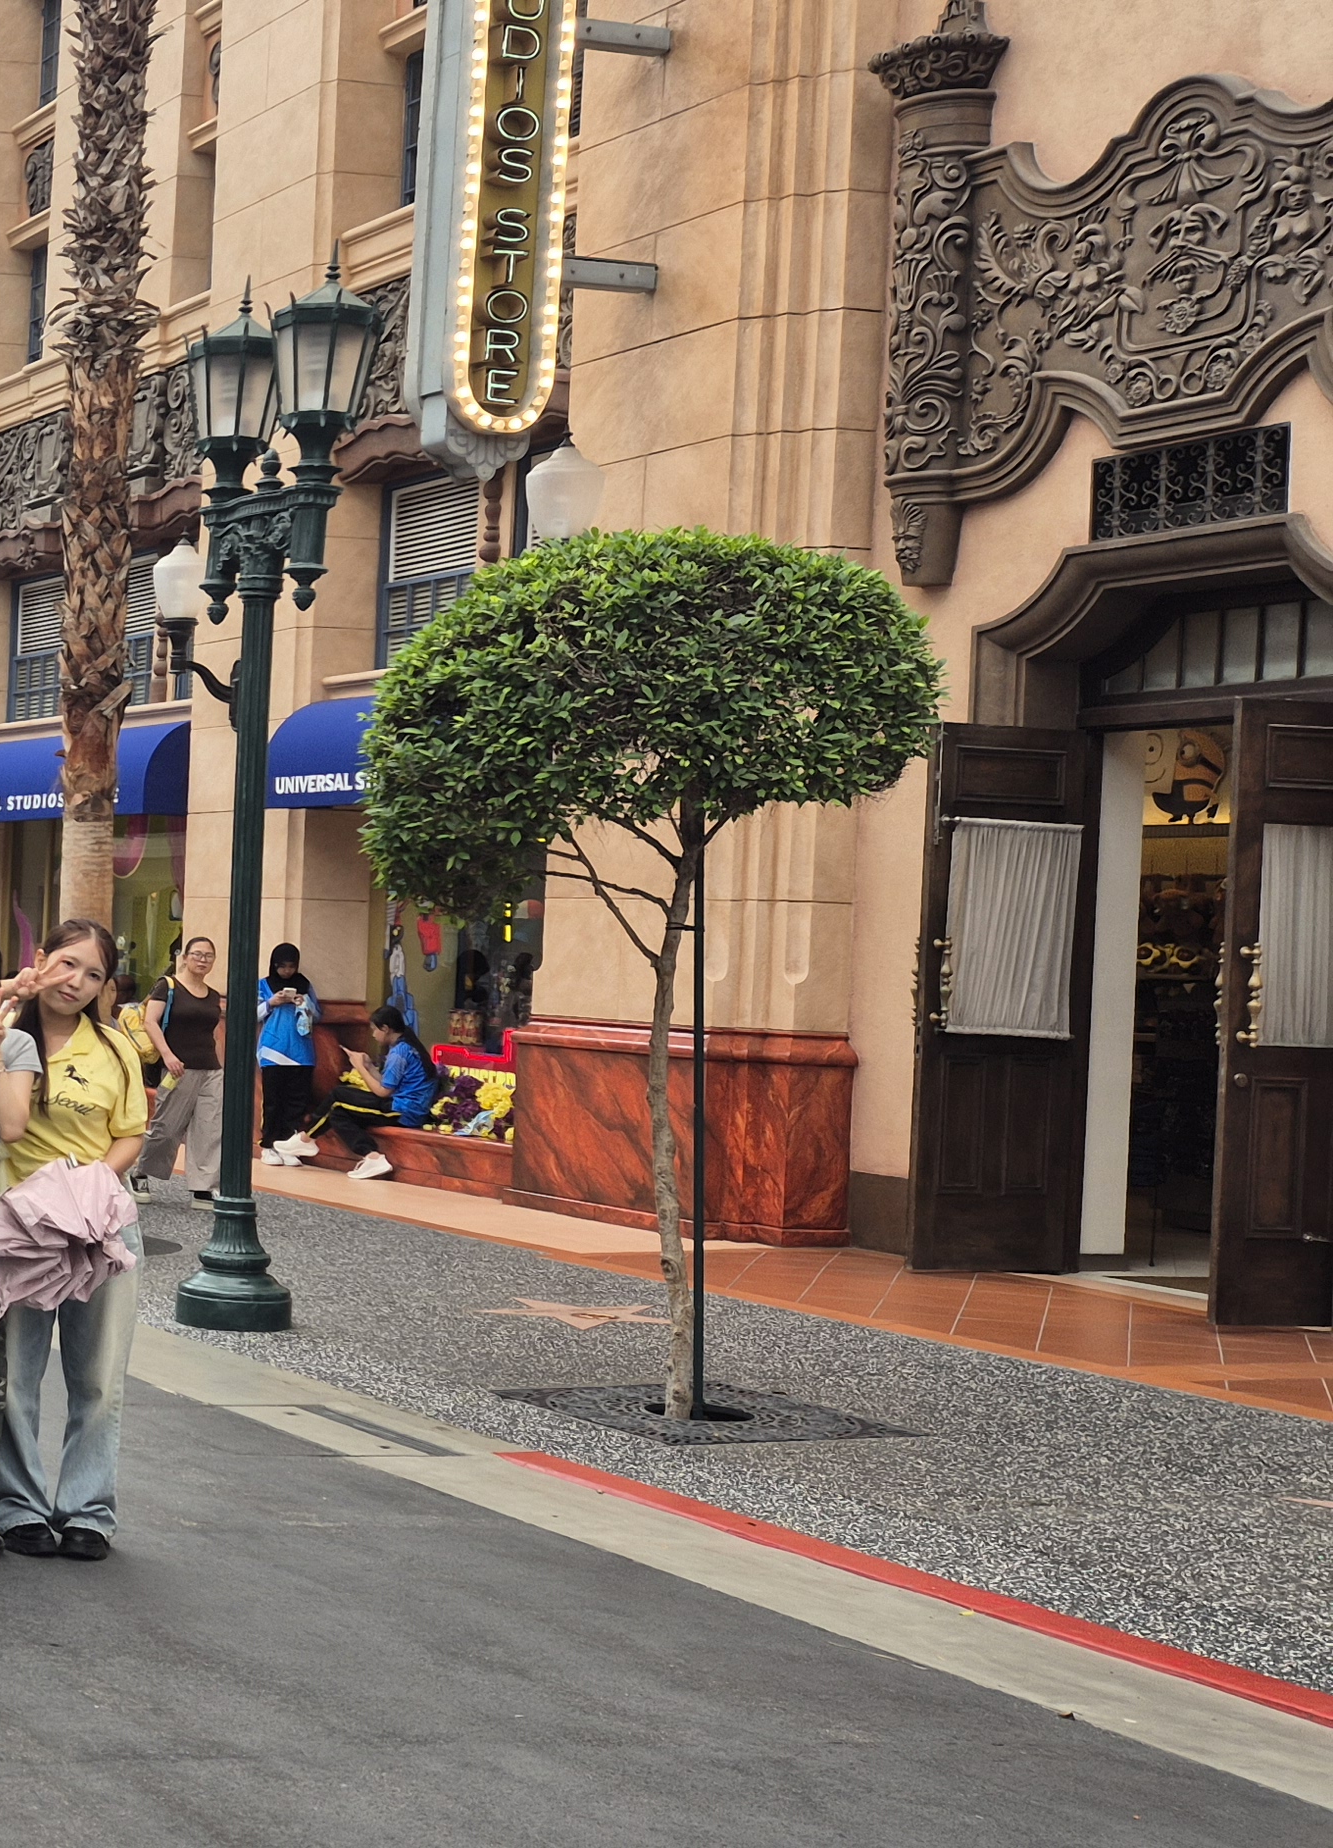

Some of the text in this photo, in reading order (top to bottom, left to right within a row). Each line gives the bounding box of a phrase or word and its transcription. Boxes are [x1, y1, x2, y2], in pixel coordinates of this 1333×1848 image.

[483, 206, 531, 406] STORE
[275, 773, 353, 795] UNIVERSAL
[6, 792, 65, 811] STUDIOS
[45, 1090, 97, 1116] Seoul
